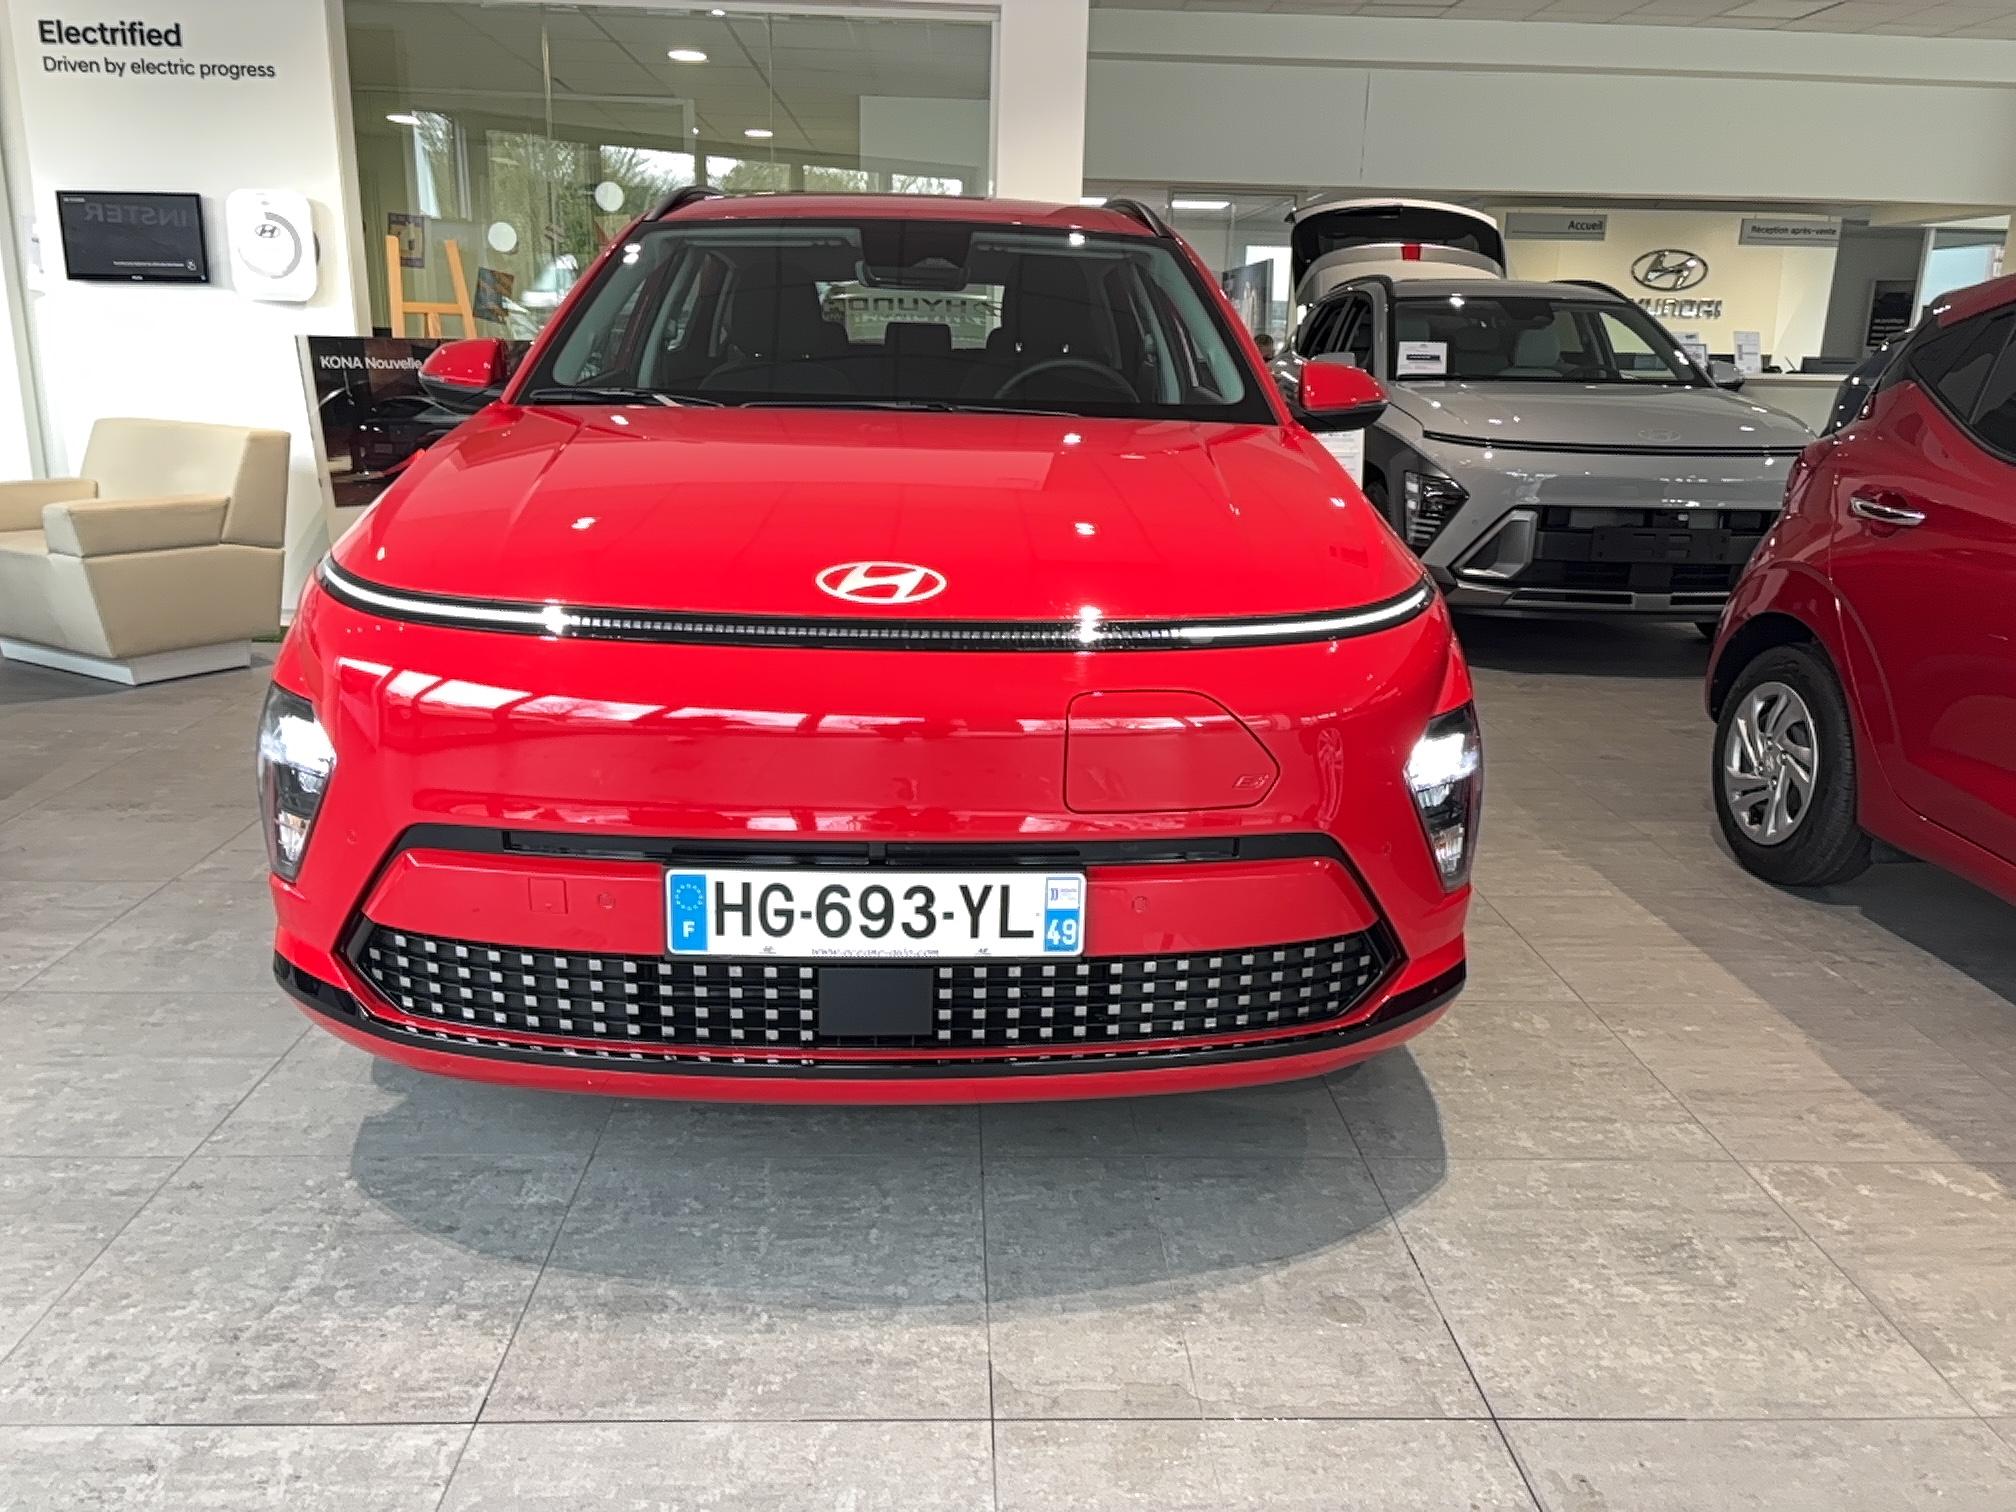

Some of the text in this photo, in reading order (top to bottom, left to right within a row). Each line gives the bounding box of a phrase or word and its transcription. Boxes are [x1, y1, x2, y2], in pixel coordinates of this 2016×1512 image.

[38, 19, 182, 47] Electrified
[43, 56, 276, 80] Driven by electric progress
[1568, 220, 1603, 230] Accueil
[320, 355, 423, 370] KONA Nouvelle
[714, 881, 1034, 939] HG-693-YL
[682, 921, 695, 937] F
[1047, 919, 1077, 945] 49
